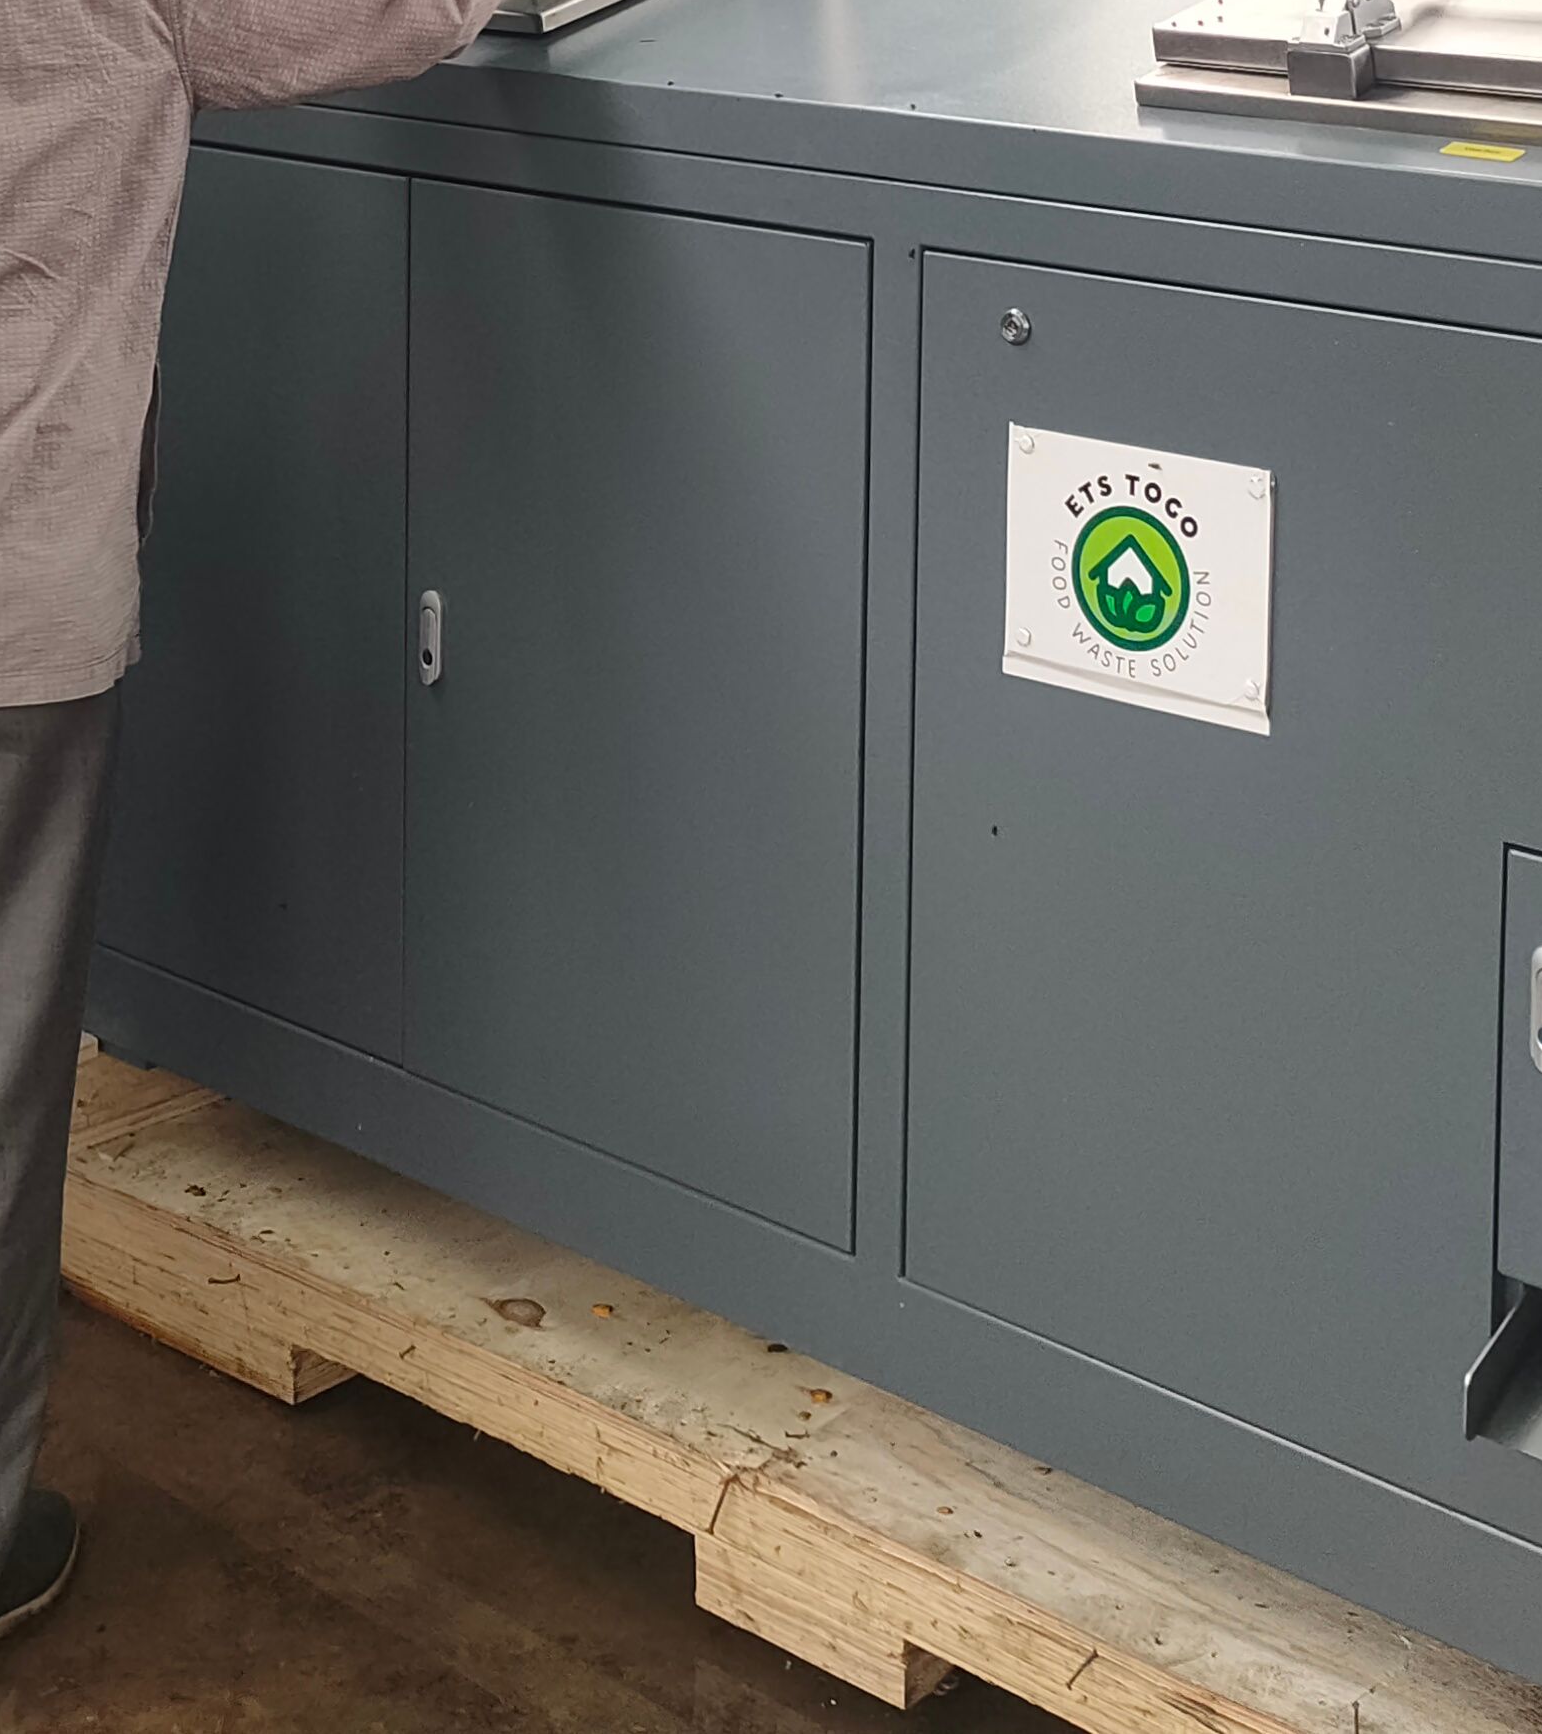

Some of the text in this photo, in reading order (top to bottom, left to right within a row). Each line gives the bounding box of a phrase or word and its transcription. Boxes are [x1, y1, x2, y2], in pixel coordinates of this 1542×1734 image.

[1065, 473, 1199, 538] ETS TOGO
[1051, 539, 1211, 679] FOOD WASTE SOLUTION
